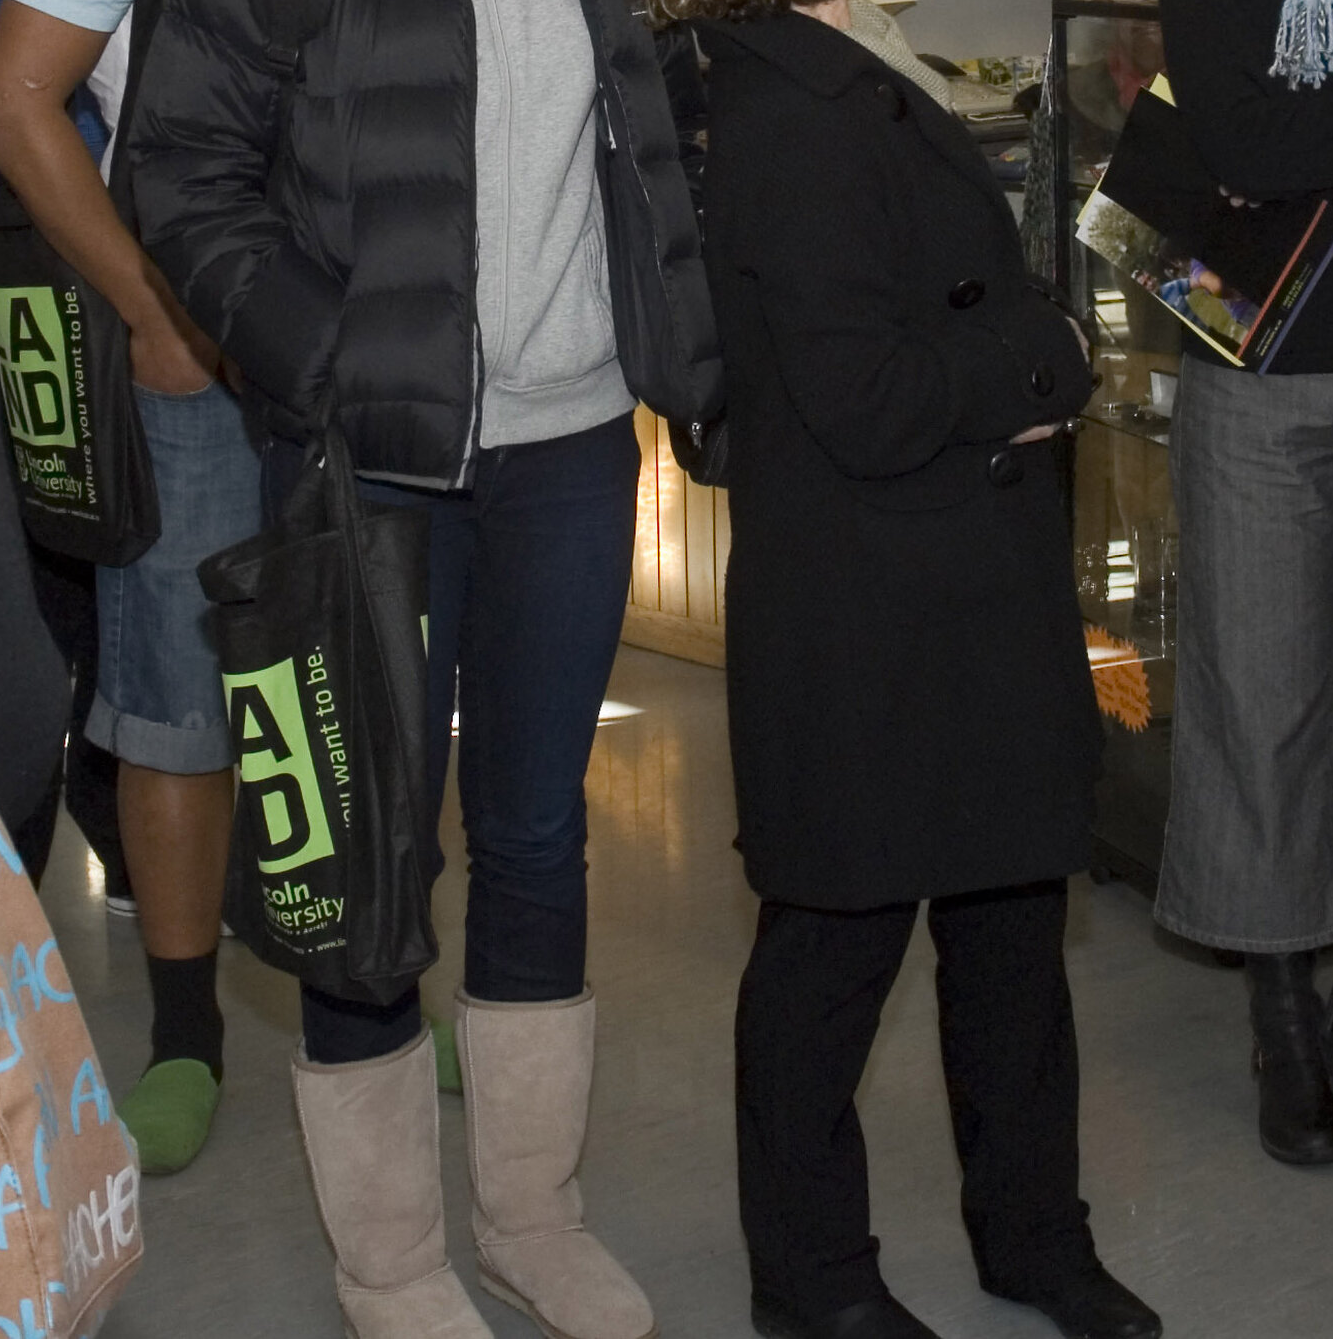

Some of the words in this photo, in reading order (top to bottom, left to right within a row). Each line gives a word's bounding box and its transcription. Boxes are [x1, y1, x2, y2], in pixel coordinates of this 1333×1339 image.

[65, 285, 80, 314] be.
[70, 320, 82, 340] to
[71, 347, 86, 398] want
[77, 403, 92, 439] you
[82, 445, 97, 504] where
[307, 646, 328, 685] be.
[315, 690, 335, 717] to
[320, 720, 351, 786] want
